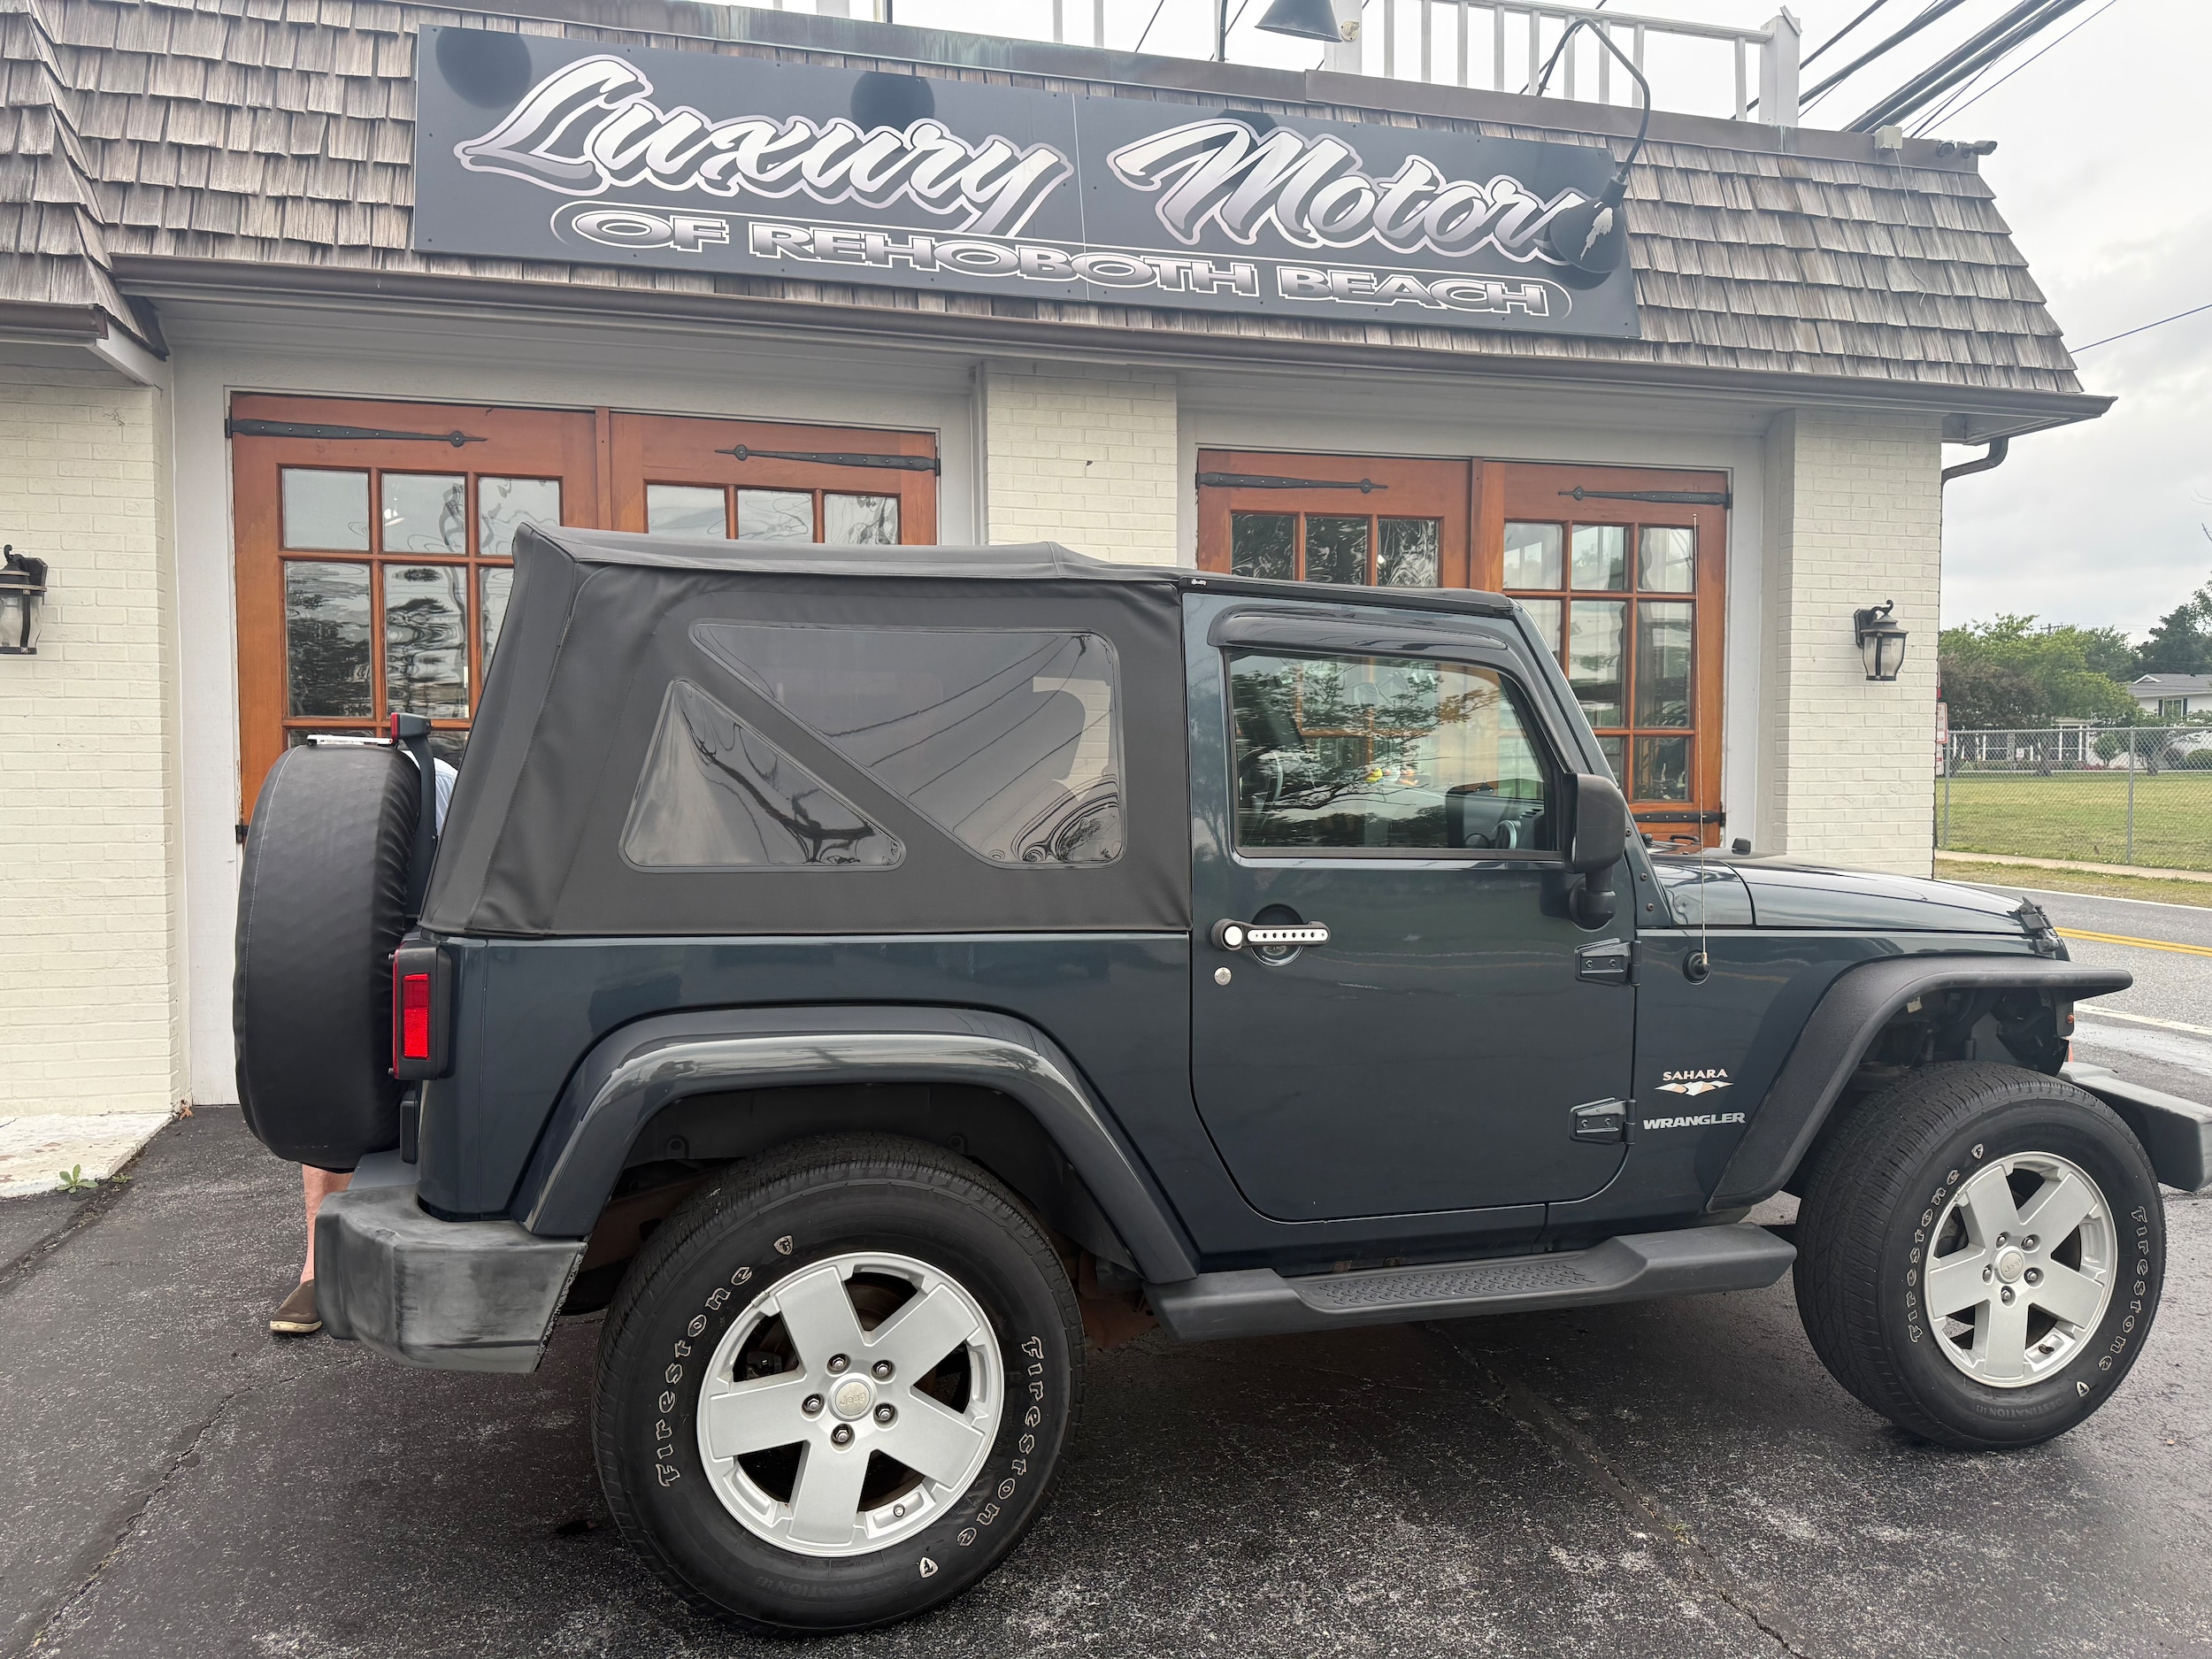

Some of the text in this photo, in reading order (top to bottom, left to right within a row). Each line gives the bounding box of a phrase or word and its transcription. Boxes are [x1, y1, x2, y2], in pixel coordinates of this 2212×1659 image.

[453, 54, 1592, 266] Luxury Motor
[572, 210, 1549, 317] OF REHOBOTH BEACH
[1643, 1112, 1746, 1130] WRANGLER
[1663, 1068, 1728, 1081] SAHARA
[1906, 1170, 1960, 1343] Firestone
[2099, 1205, 2149, 1371] Firestone
[655, 1267, 753, 1487] Firestone
[840, 1392, 866, 1406] Jeep
[956, 1335, 1045, 1547] Firestone
